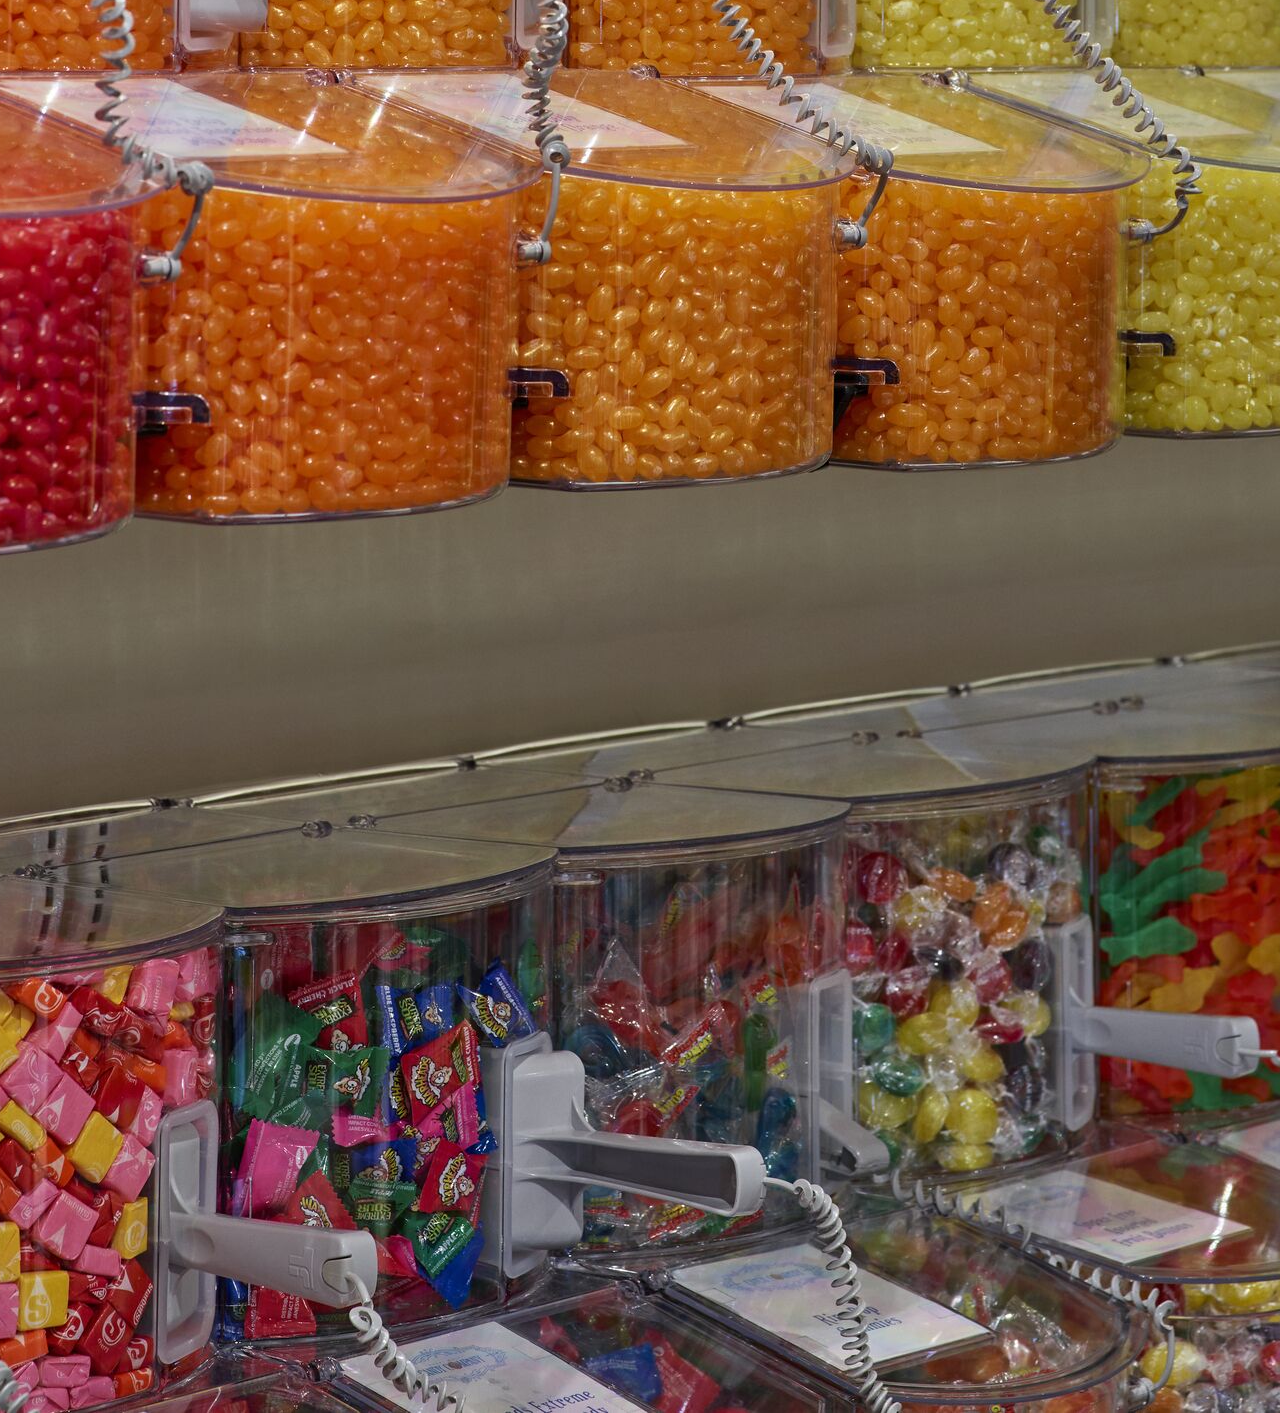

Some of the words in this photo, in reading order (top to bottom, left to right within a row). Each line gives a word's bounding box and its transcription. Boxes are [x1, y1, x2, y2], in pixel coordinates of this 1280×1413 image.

[329, 976, 355, 994] BLACK
[383, 985, 394, 1006] BLUE
[290, 1064, 302, 1088] APPLE
[414, 1056, 439, 1108] WARHEADS
[355, 1210, 392, 1221] EXTREME
[357, 1202, 392, 1212] SOUR
[528, 1390, 596, 1413] Extreme
